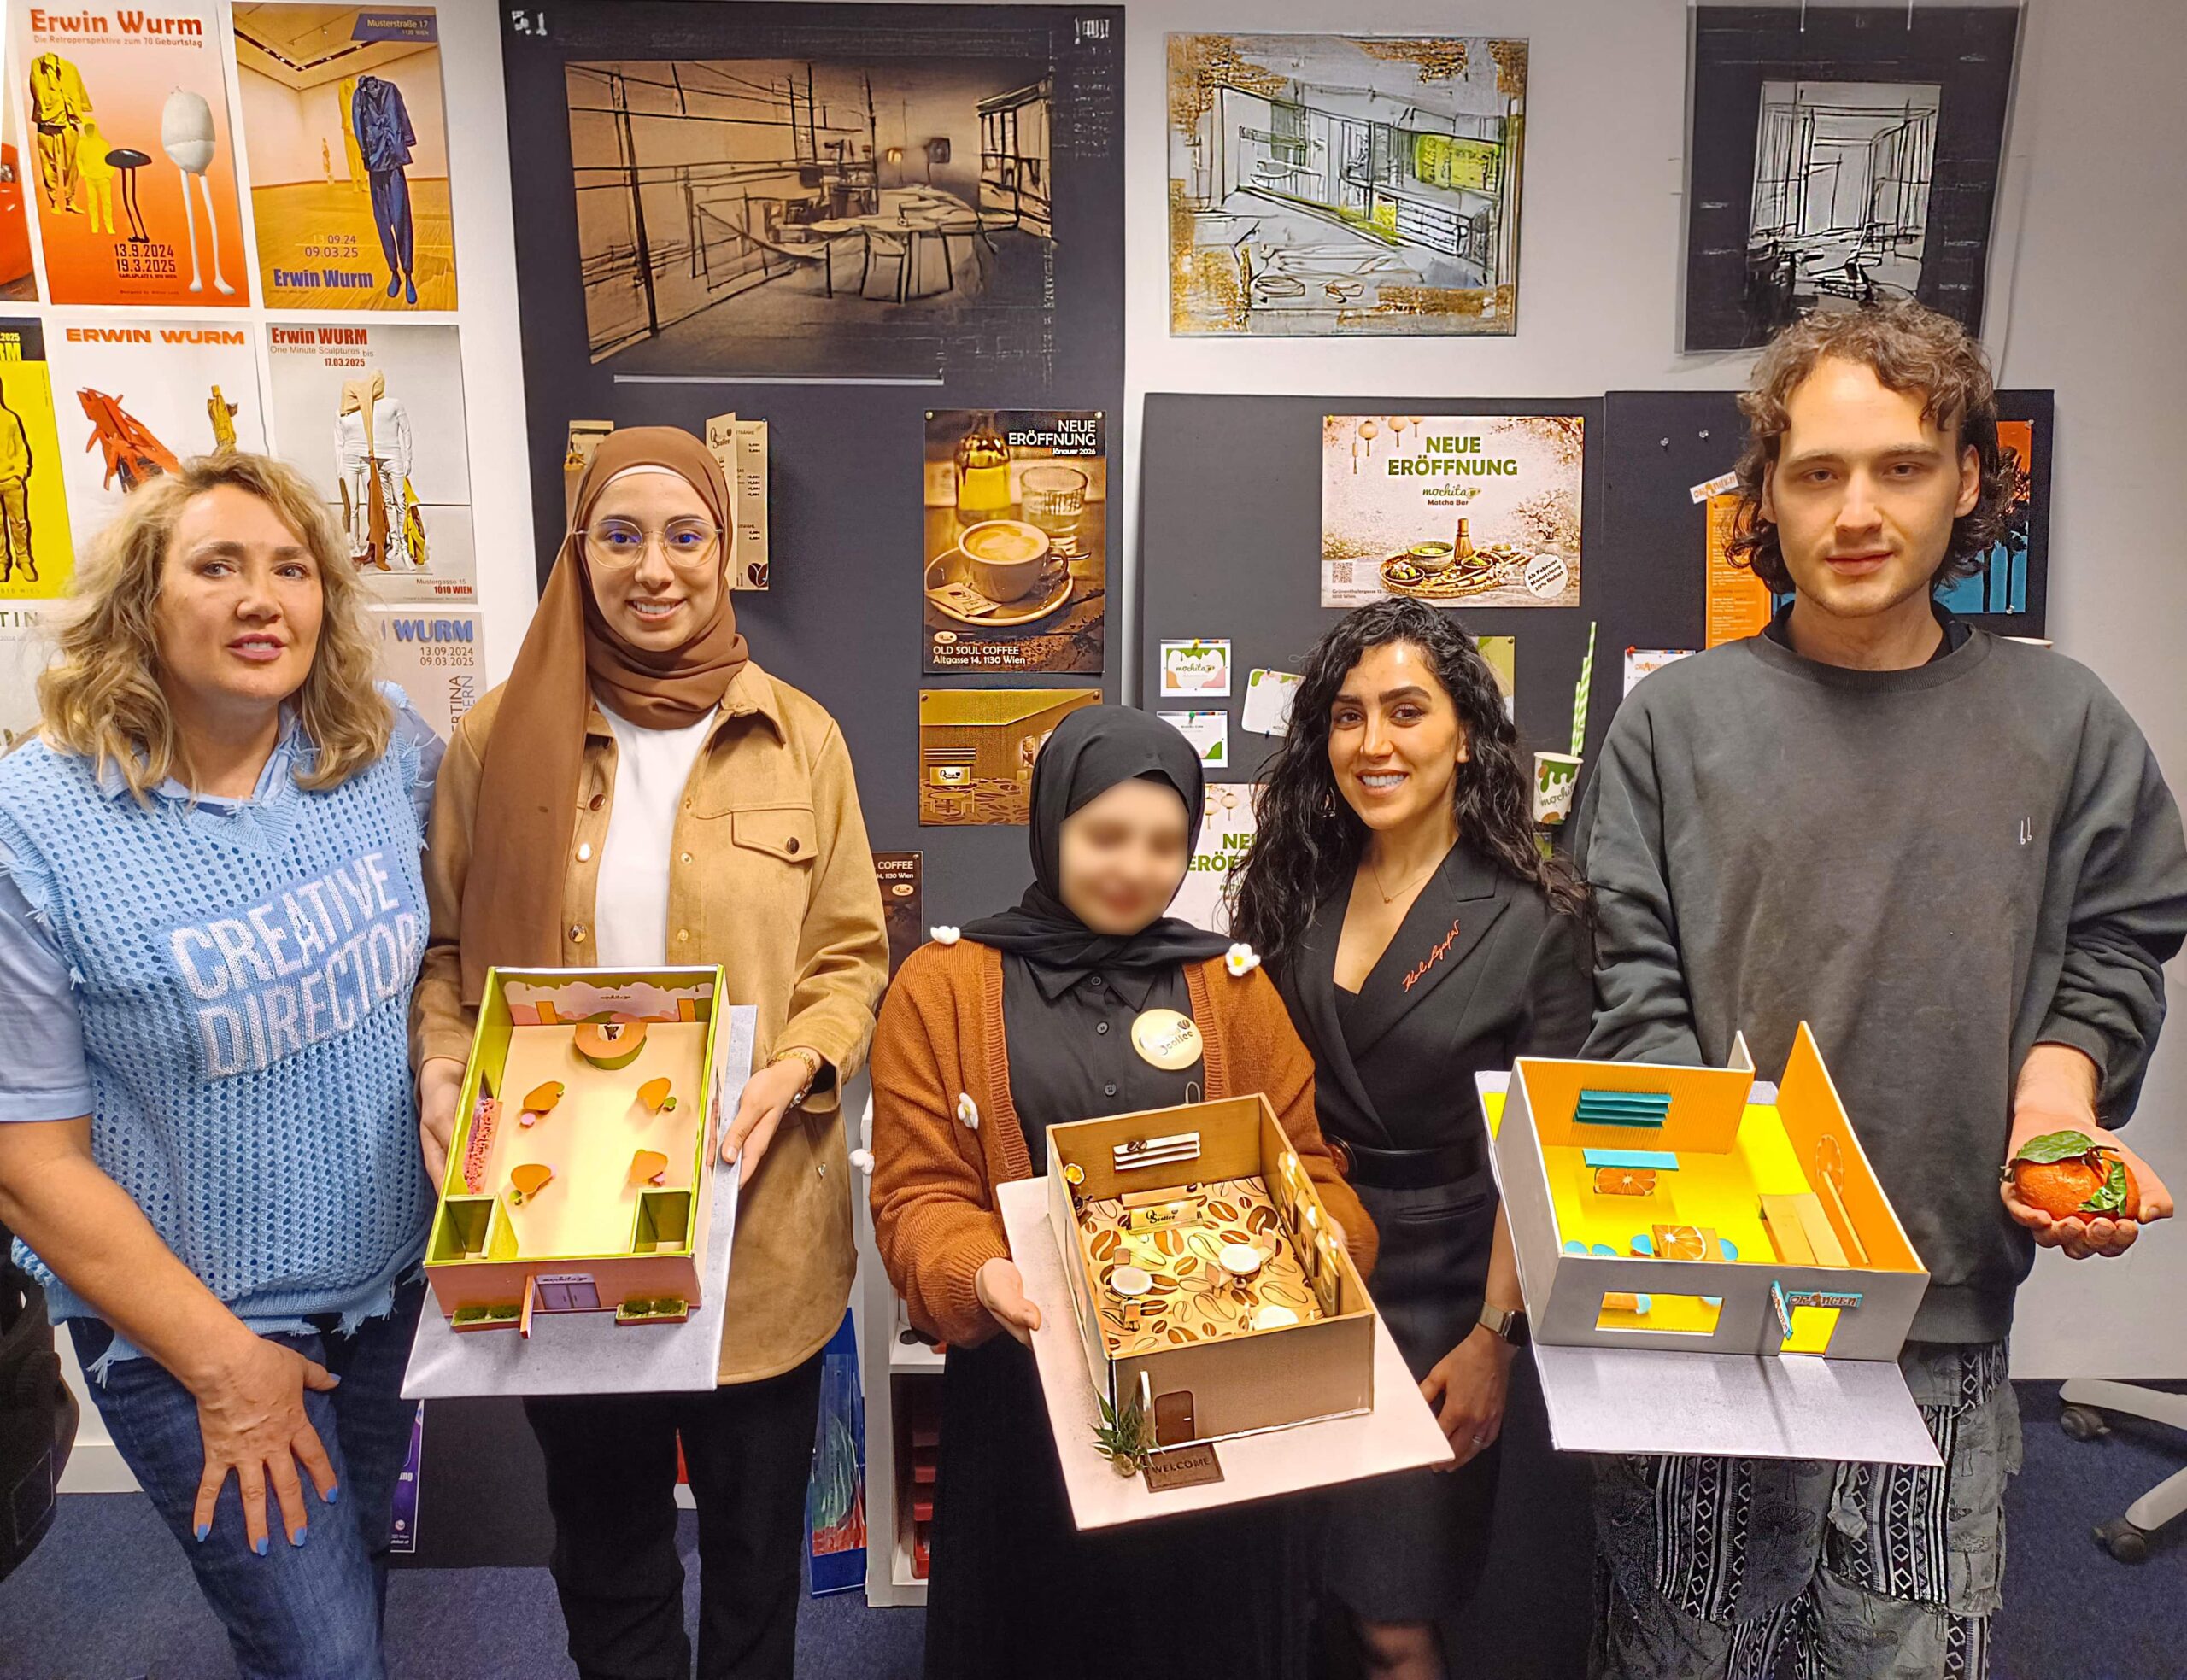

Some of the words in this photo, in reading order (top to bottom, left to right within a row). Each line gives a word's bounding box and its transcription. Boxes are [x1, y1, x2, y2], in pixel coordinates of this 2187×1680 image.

[31, 9, 108, 33] Erwin
[117, 10, 202, 35] Wurm
[367, 18, 417, 28] Musterstraße
[419, 20, 429, 28] 17
[50, 36, 121, 45] Retroperspektive
[155, 38, 202, 48] Geburtstag
[114, 243, 174, 258] 13.9.2024
[305, 246, 359, 258] 09.03.25
[117, 259, 176, 273] 19.3.2025
[273, 268, 320, 287] Erwin
[322, 269, 374, 288] Wurm
[66, 328, 152, 343] ERWIN
[160, 330, 245, 345] WURM
[271, 327, 315, 344] Erwin
[317, 327, 368, 345] WURM
[270, 345, 288, 354] One
[290, 346, 316, 354] Minute
[319, 346, 361, 355] Sculptures
[324, 358, 366, 367] 17.03.2025
[1058, 419, 1096, 432] NEUE
[1008, 430, 1096, 446] ERÖFFNUNG
[1426, 436, 1481, 454] NEUE
[1388, 455, 1518, 476] ERÖFFNUNG
[1422, 483, 1467, 497] mochita
[434, 585, 451, 594] 1010
[453, 586, 472, 594] WIEN
[392, 619, 474, 642] WURM
[419, 647, 473, 657] 13.09.2024
[933, 646, 954, 655] OLD
[956, 646, 982, 655] SOUL
[982, 646, 1020, 655] COFFEE
[419, 657, 474, 666] 09.03.2025
[933, 655, 969, 665] Altgasse
[970, 656, 982, 664] 14,
[983, 655, 1001, 664] 1130
[1003, 655, 1025, 664] Wien
[877, 860, 914, 869] COFFEE
[170, 852, 400, 1001] CREATIVE
[199, 912, 417, 1078] DIRECTOR
[1152, 1457, 1211, 1474] WELCOME
